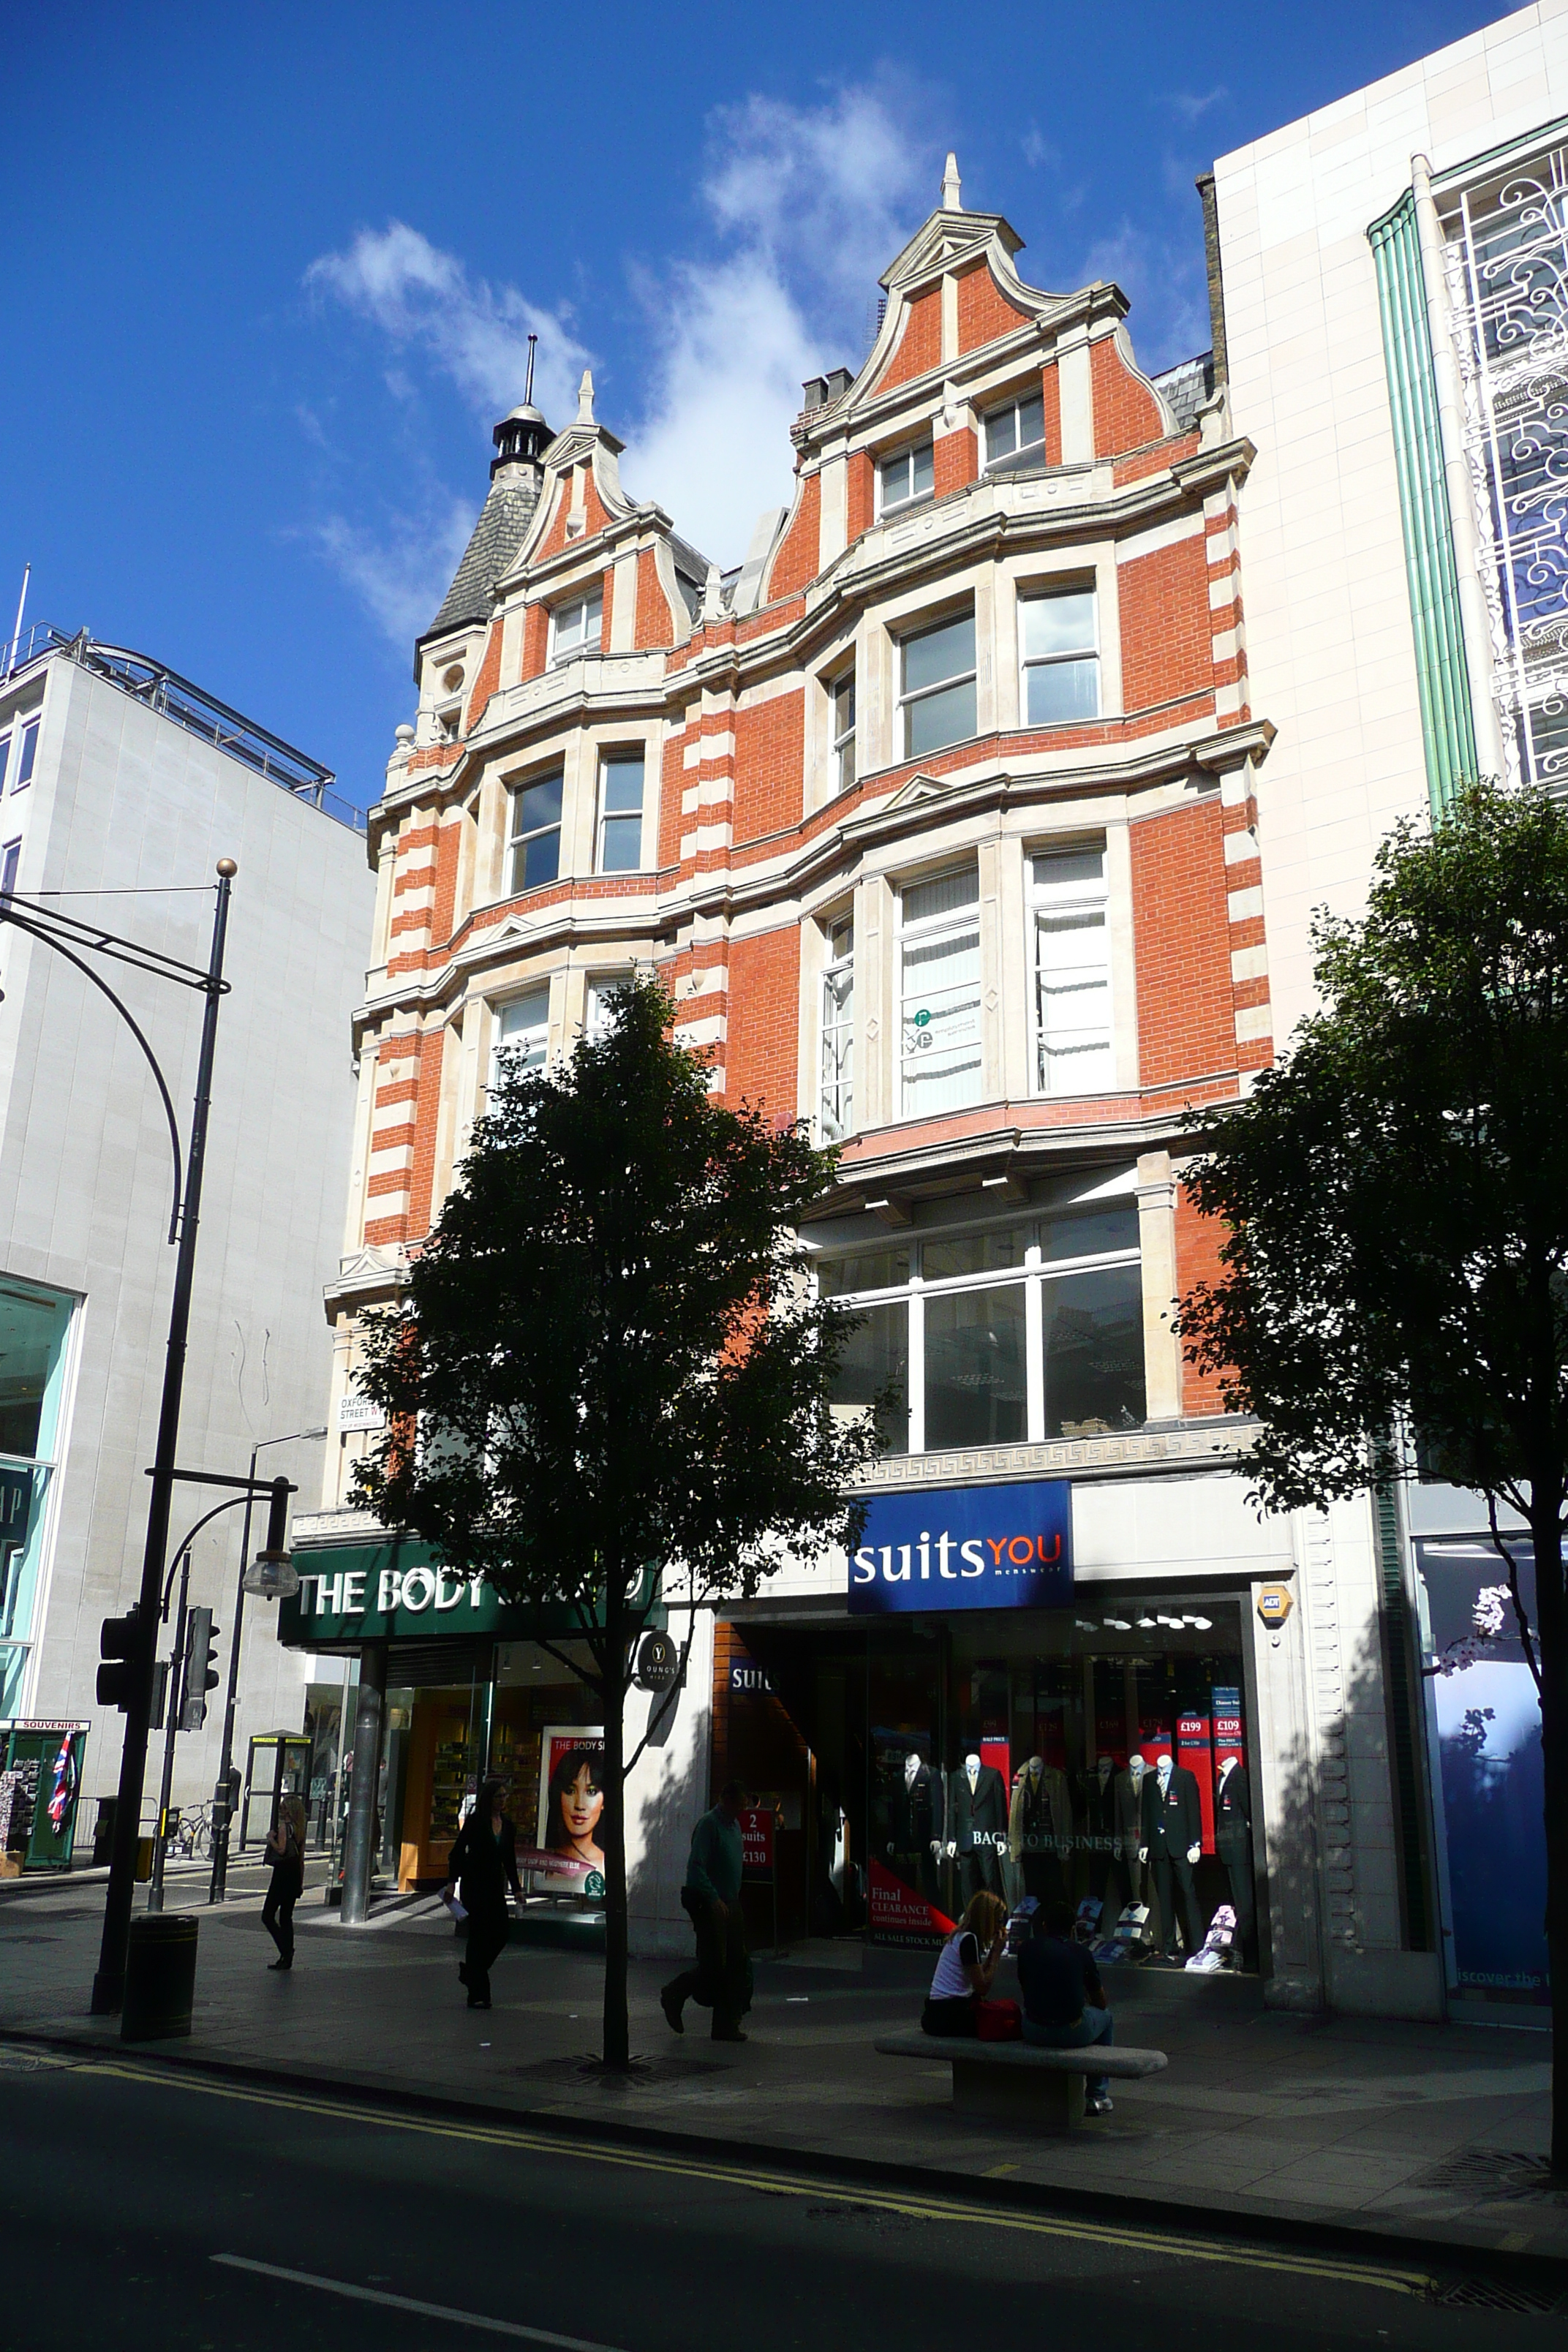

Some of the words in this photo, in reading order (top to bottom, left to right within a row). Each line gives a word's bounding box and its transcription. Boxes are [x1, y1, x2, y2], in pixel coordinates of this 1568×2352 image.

[340, 1408, 369, 1420] STREET
[995, 1566, 1061, 1576] menswear
[298, 1572, 366, 1615] THE
[377, 1564, 488, 1612] BODY
[1264, 1597, 1279, 1607] ADT
[1180, 1722, 1202, 1732] £199
[1217, 1720, 1240, 1730] £109
[555, 1741, 570, 1750] THE
[573, 1741, 596, 1750] BODY
[750, 1814, 757, 1828] 2
[742, 1830, 766, 1842] suits
[1044, 1834, 1123, 1850] BUSINESS
[742, 1851, 766, 1863] £130
[872, 1887, 901, 1901] Final
[872, 1901, 930, 1915] CLEARANCE
[872, 1915, 907, 1925] continues
[908, 1916, 932, 1926] inside
[874, 1932, 886, 1940] ALL
[887, 1934, 904, 1942] SALE
[905, 1935, 930, 1945] STOCK
